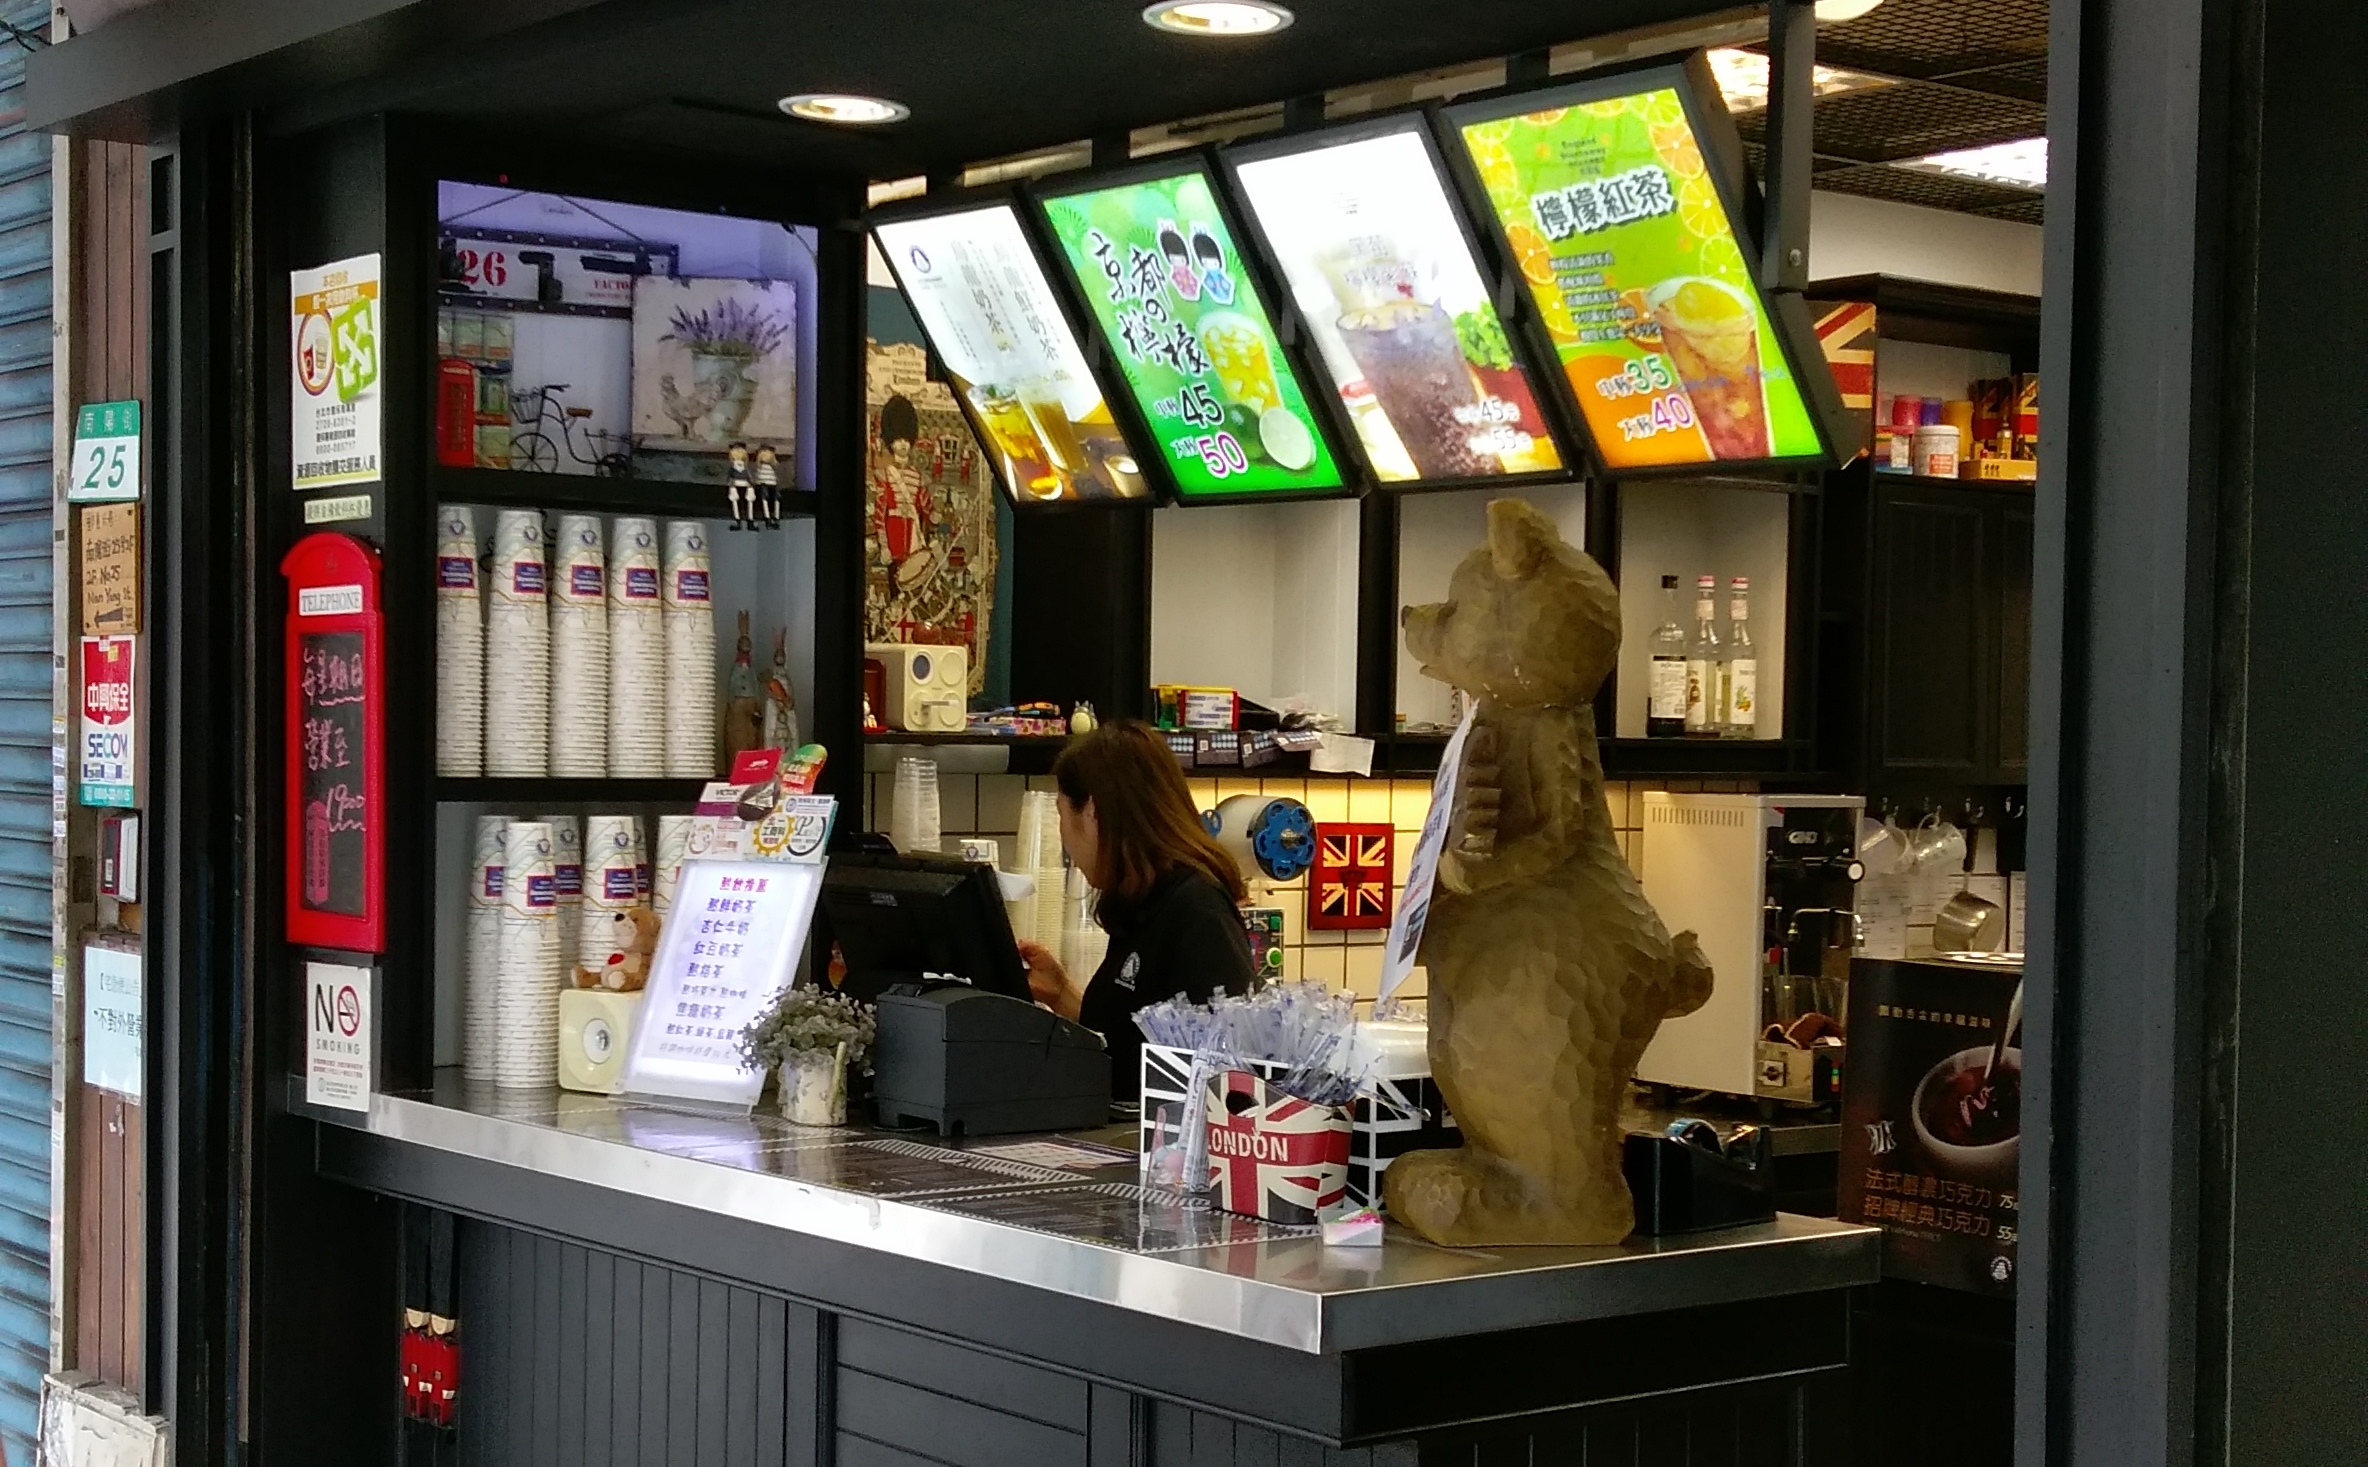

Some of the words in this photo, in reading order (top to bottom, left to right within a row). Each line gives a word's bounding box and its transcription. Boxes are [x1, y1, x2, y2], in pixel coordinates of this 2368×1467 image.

[1535, 168, 1669, 236] 檸檬紅茶
[455, 249, 507, 288] 26
[81, 444, 126, 489] 25
[302, 592, 361, 613] TELEPHONE
[88, 732, 128, 759] SECOM
[315, 1038, 361, 1055] SMOKING
[1207, 1127, 1289, 1162] ONDON
